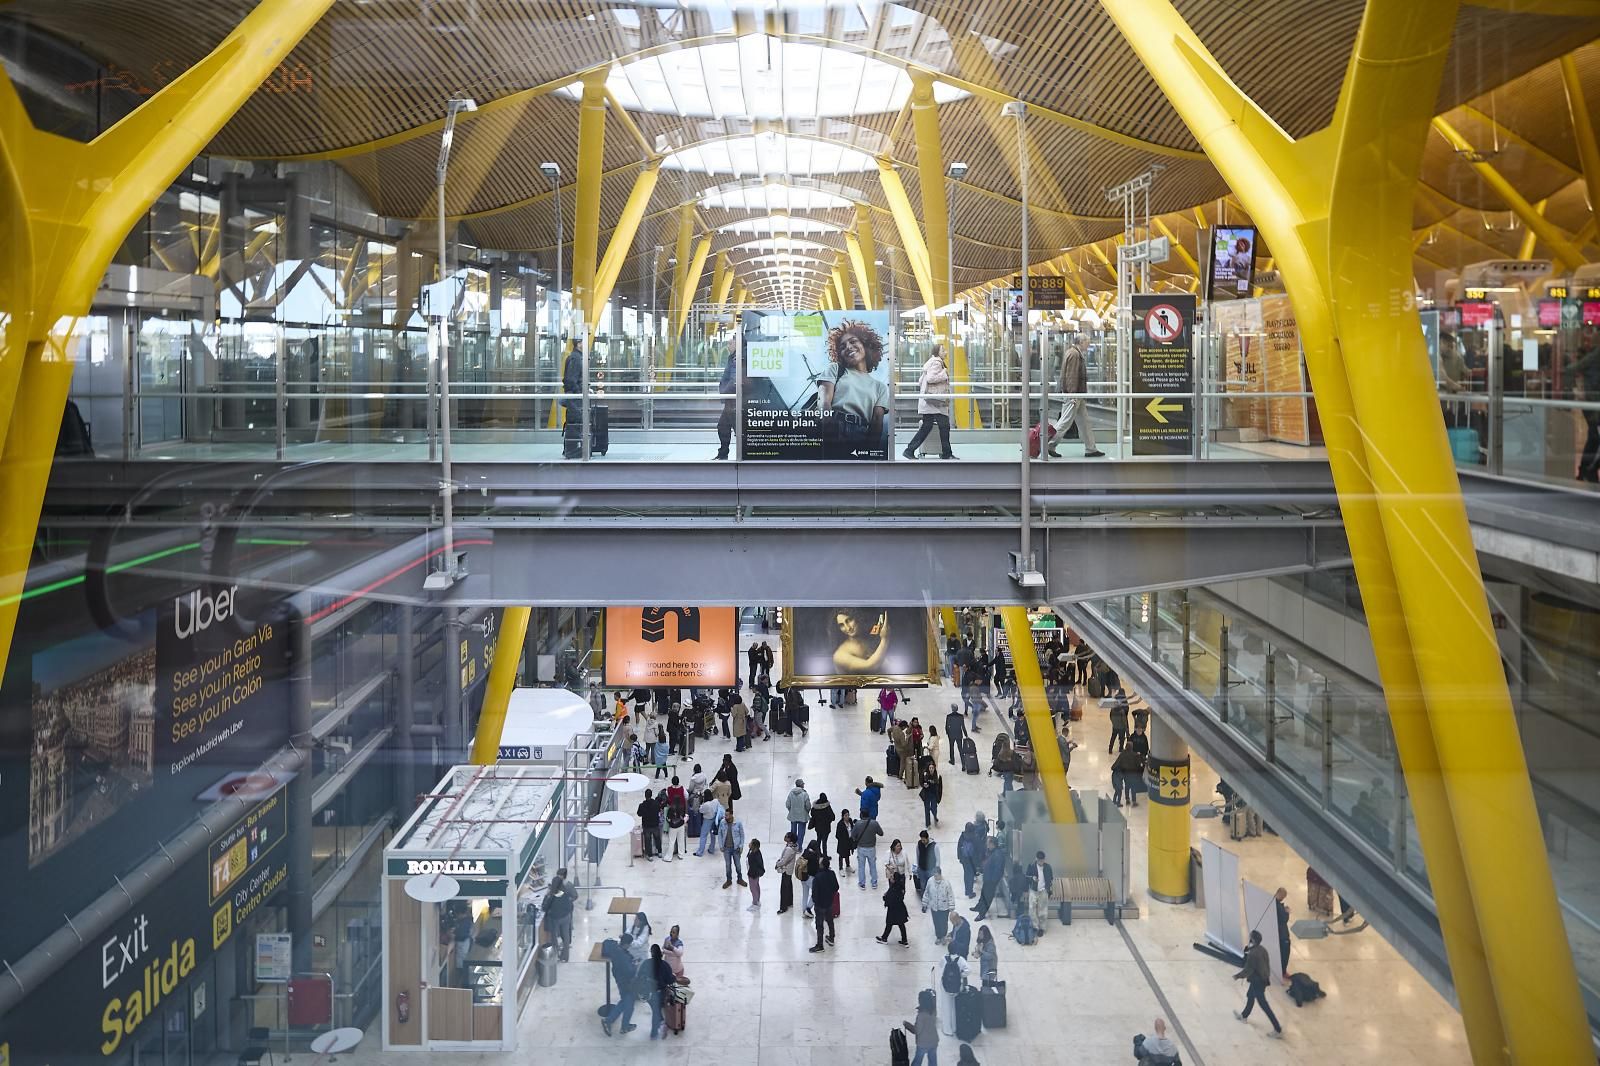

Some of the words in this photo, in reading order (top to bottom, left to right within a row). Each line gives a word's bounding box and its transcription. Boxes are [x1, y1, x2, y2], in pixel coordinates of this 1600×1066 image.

[1466, 291, 1485, 299] 850
[1550, 287, 1567, 298] 851
[752, 348, 784, 358] PLAN
[752, 360, 783, 370] PLUS
[747, 408, 789, 419] Siempre
[804, 408, 834, 419] mejor
[748, 418, 775, 427] tener
[777, 419, 790, 427] un
[792, 418, 817, 429] plan.
[175, 585, 238, 639] Uber
[173, 668, 198, 692] See
[200, 656, 220, 683] you
[223, 648, 231, 665] in
[234, 634, 257, 658] Gran
[259, 623, 273, 643] Vía
[483, 636, 497, 669] Sali
[673, 661, 689, 669] here
[691, 661, 698, 669] to
[677, 669, 696, 677] from
[173, 692, 197, 717] See
[200, 679, 220, 708] you
[222, 672, 231, 689] in
[233, 656, 260, 682] Retiro
[172, 718, 196, 743] See
[199, 702, 219, 733] you
[222, 695, 230, 713] in
[232, 675, 262, 704] Colón
[171, 752, 195, 775] Explore
[196, 735, 217, 758] Madrid
[218, 727, 230, 743] with
[230, 719, 244, 735] Uber
[498, 749, 515, 758] AXI
[247, 814, 257, 828] Bus
[213, 860, 230, 892] T4
[407, 860, 488, 875] RODILLA
[235, 888, 248, 907] City
[250, 866, 270, 892] Center
[237, 893, 261, 924] Centro
[263, 863, 287, 896] Ciudad
[102, 913, 149, 990] Exit
[101, 937, 196, 1056] Salida
